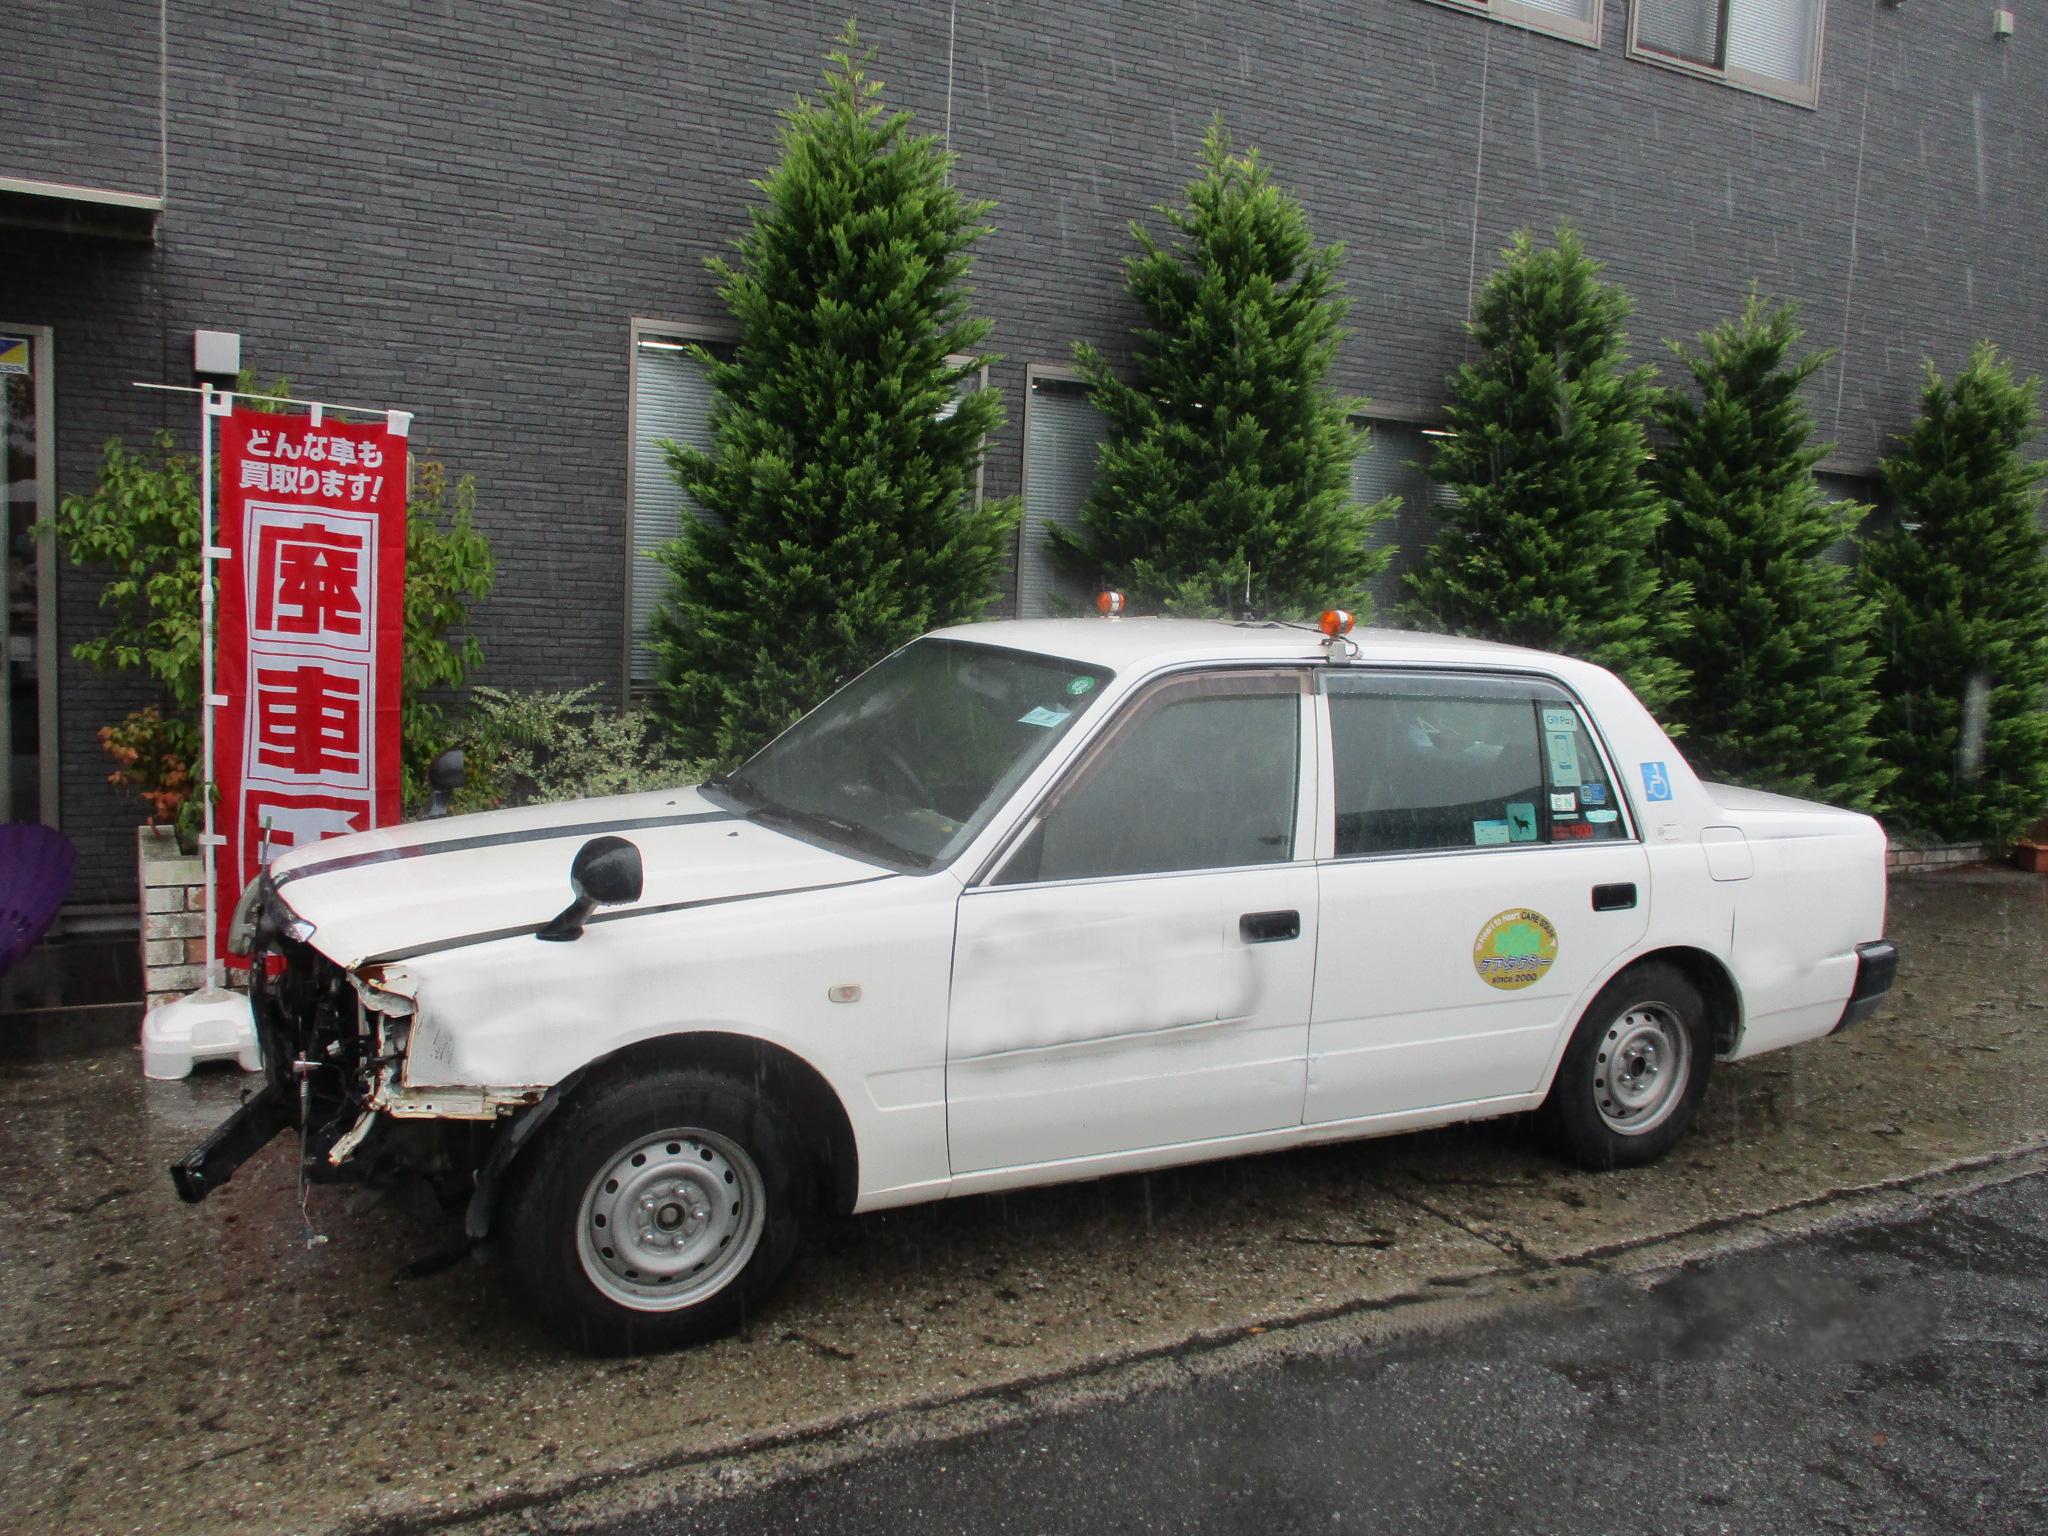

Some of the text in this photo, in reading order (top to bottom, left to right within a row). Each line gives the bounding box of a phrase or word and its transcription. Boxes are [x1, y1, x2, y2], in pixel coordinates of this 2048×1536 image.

[246, 429, 383, 468] どんな車も
[239, 459, 384, 503] 買取ります!
[1560, 715, 1574, 727] Pay
[1521, 912, 1540, 925] CARE
[1492, 973, 1537, 984] since 2000
